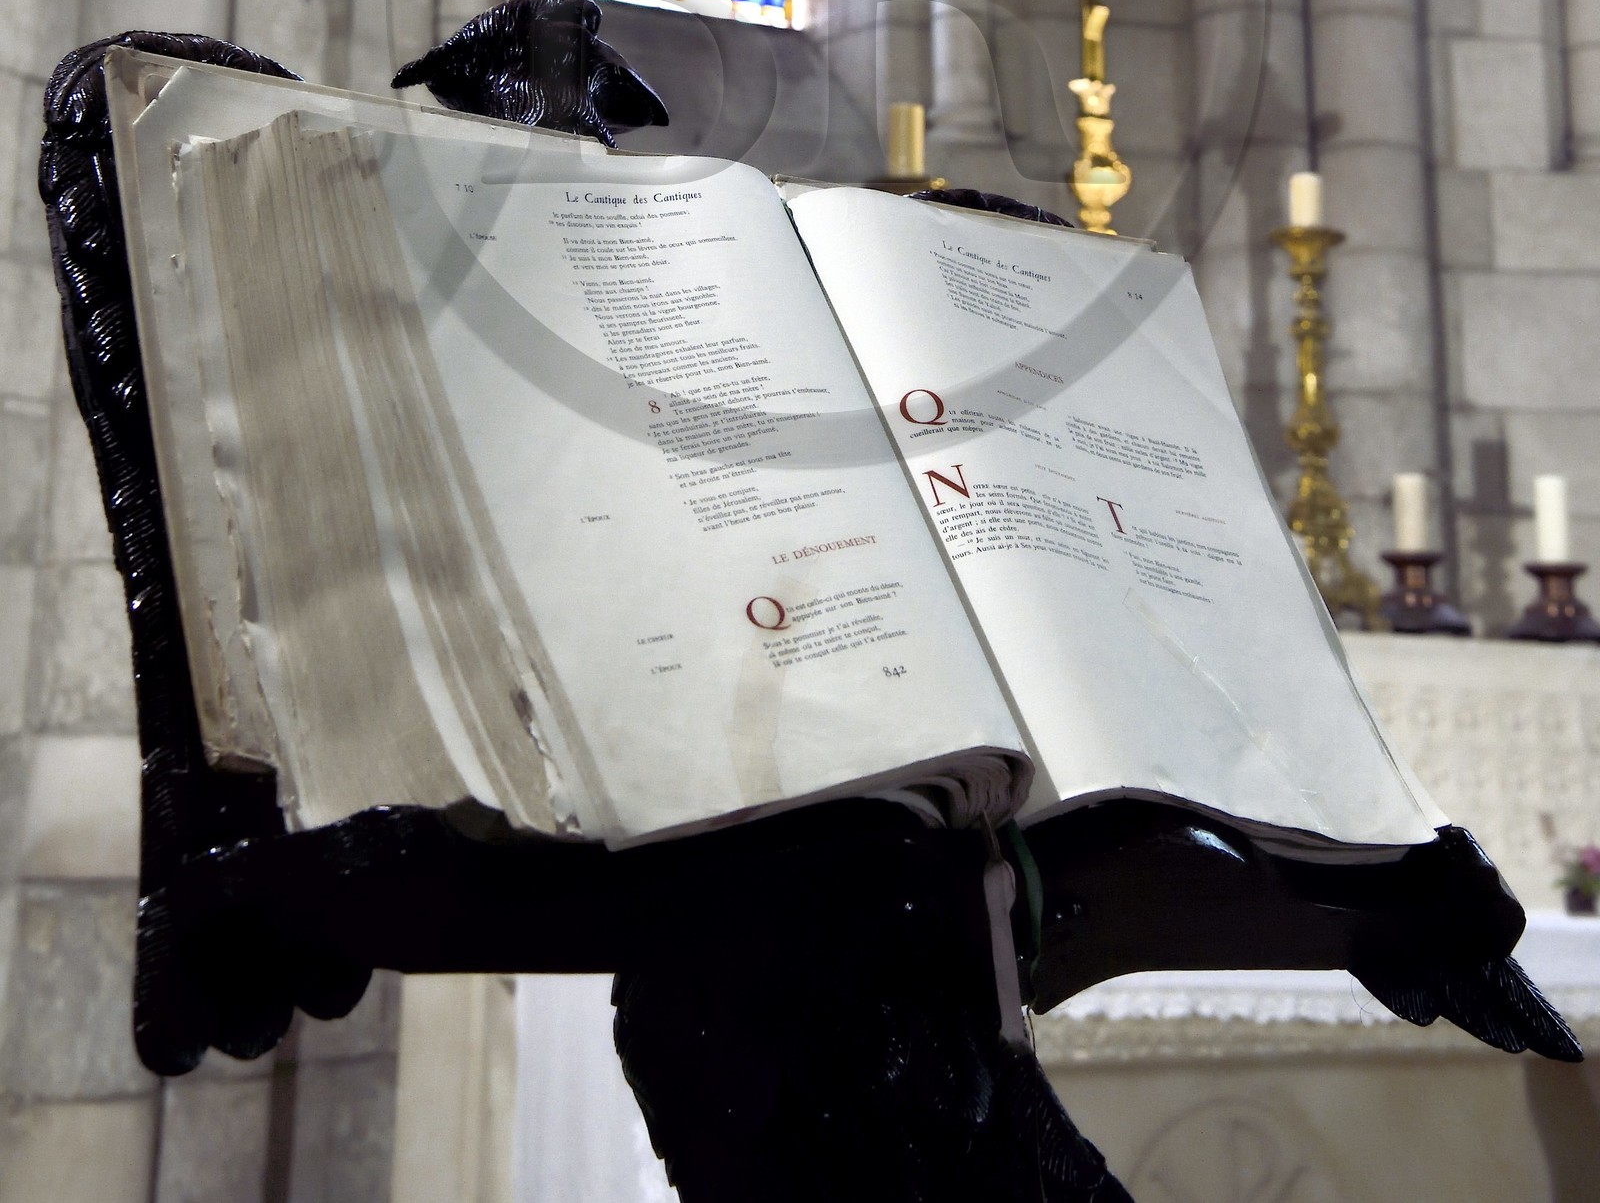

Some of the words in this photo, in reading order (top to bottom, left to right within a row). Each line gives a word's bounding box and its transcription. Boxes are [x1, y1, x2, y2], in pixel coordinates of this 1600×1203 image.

[464, 184, 474, 193] 10
[565, 191, 578, 202] Le
[584, 192, 626, 207] Cantique
[632, 194, 647, 204] des
[653, 191, 702, 202] Cantiques
[942, 240, 953, 251] Le
[957, 246, 992, 265] Cantique
[996, 260, 1008, 270] des
[1012, 265, 1051, 282] Cantiques
[693, 284, 720, 292] villages,
[621, 327, 656, 336] grenadiers
[628, 350, 673, 360] mandragores
[674, 343, 704, 353] exhalent
[720, 337, 748, 346] parfum,
[639, 361, 661, 369] portes
[707, 346, 739, 355] meilleurs
[637, 367, 671, 376] nouveaux
[672, 362, 697, 371] comme
[710, 355, 738, 364] anciens,
[655, 373, 683, 383] réservés
[684, 370, 701, 379] pour
[712, 380, 739, 389] m'es-tu
[750, 375, 770, 383] frère,
[648, 399, 661, 414] 8
[909, 424, 944, 438] cueillerait
[678, 450, 704, 460] liqueur
[697, 511, 732, 523] n'éveillez
[732, 508, 748, 516] pas,
[758, 498, 788, 508] réveillez
[788, 495, 802, 503] pas
[819, 488, 845, 496] amour,
[936, 506, 956, 515] sœur,
[969, 501, 983, 509] jour
[702, 522, 723, 532] avant
[723, 516, 750, 526] l'heure
[776, 506, 792, 514] bon
[951, 510, 982, 520] rempart,
[942, 520, 972, 533] d'argent
[945, 534, 958, 542] elle
[771, 553, 789, 564] LE
[792, 535, 876, 560] DÉNOUEMENT
[950, 550, 973, 561] tours.
[975, 544, 995, 553] Aussi
[997, 542, 1012, 550] ai-je
[881, 665, 908, 679] 842
